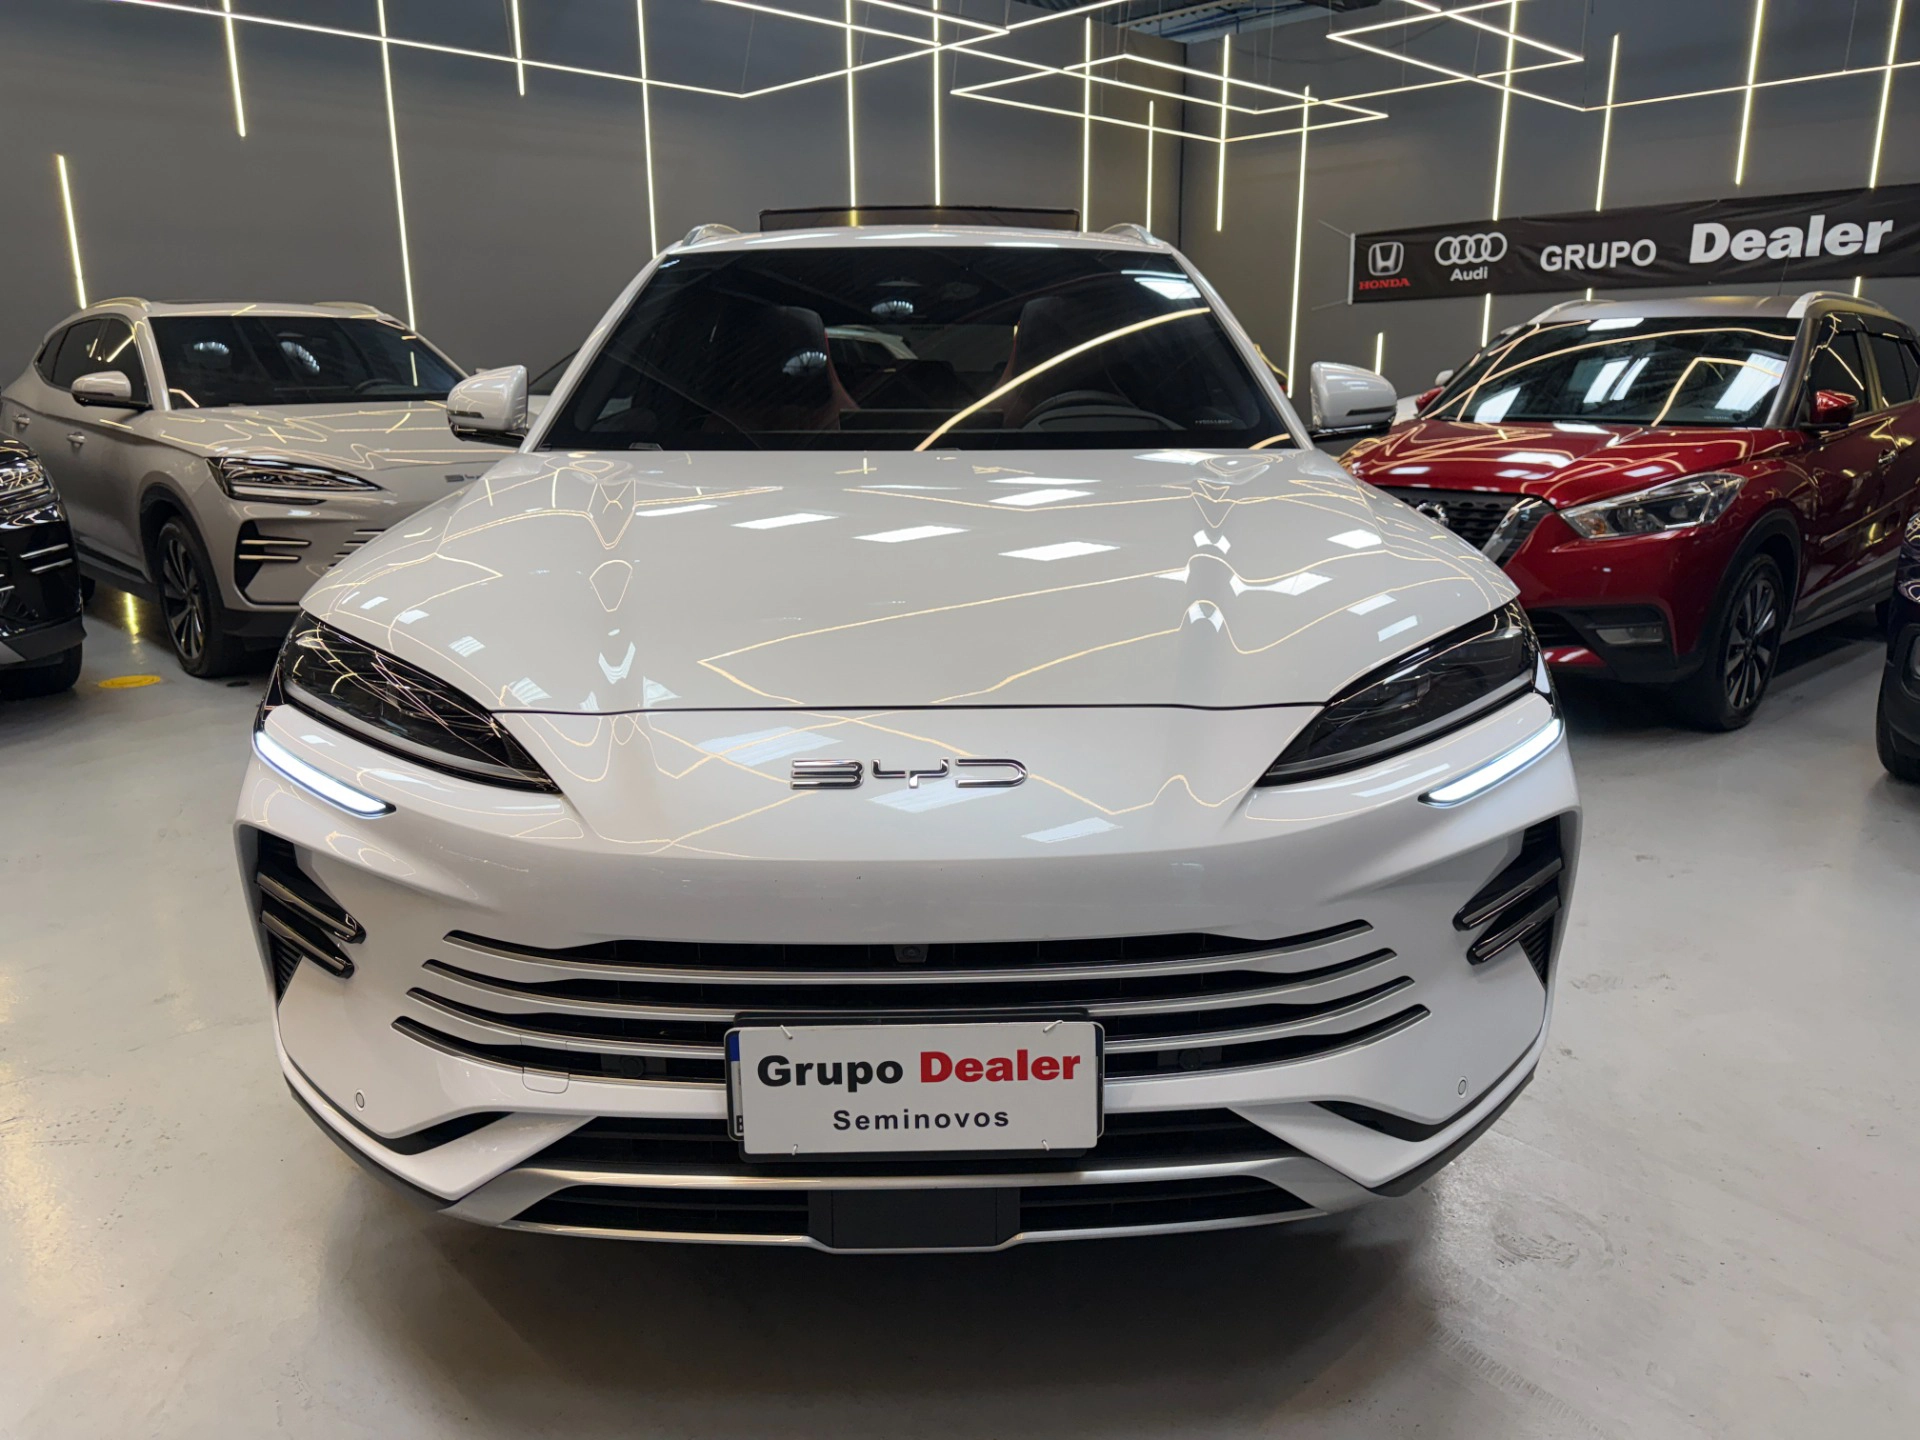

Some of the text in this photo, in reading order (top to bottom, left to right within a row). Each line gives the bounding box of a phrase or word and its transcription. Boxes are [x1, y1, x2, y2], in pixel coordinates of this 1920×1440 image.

[1539, 214, 1894, 272] GRUPO Dealer
[1358, 277, 1411, 290] HONDA
[1450, 266, 1488, 281] Audi
[790, 758, 1029, 790] BYD
[757, 1049, 1080, 1092] Grupo Dealer
[833, 1108, 1009, 1130] Seminovos
